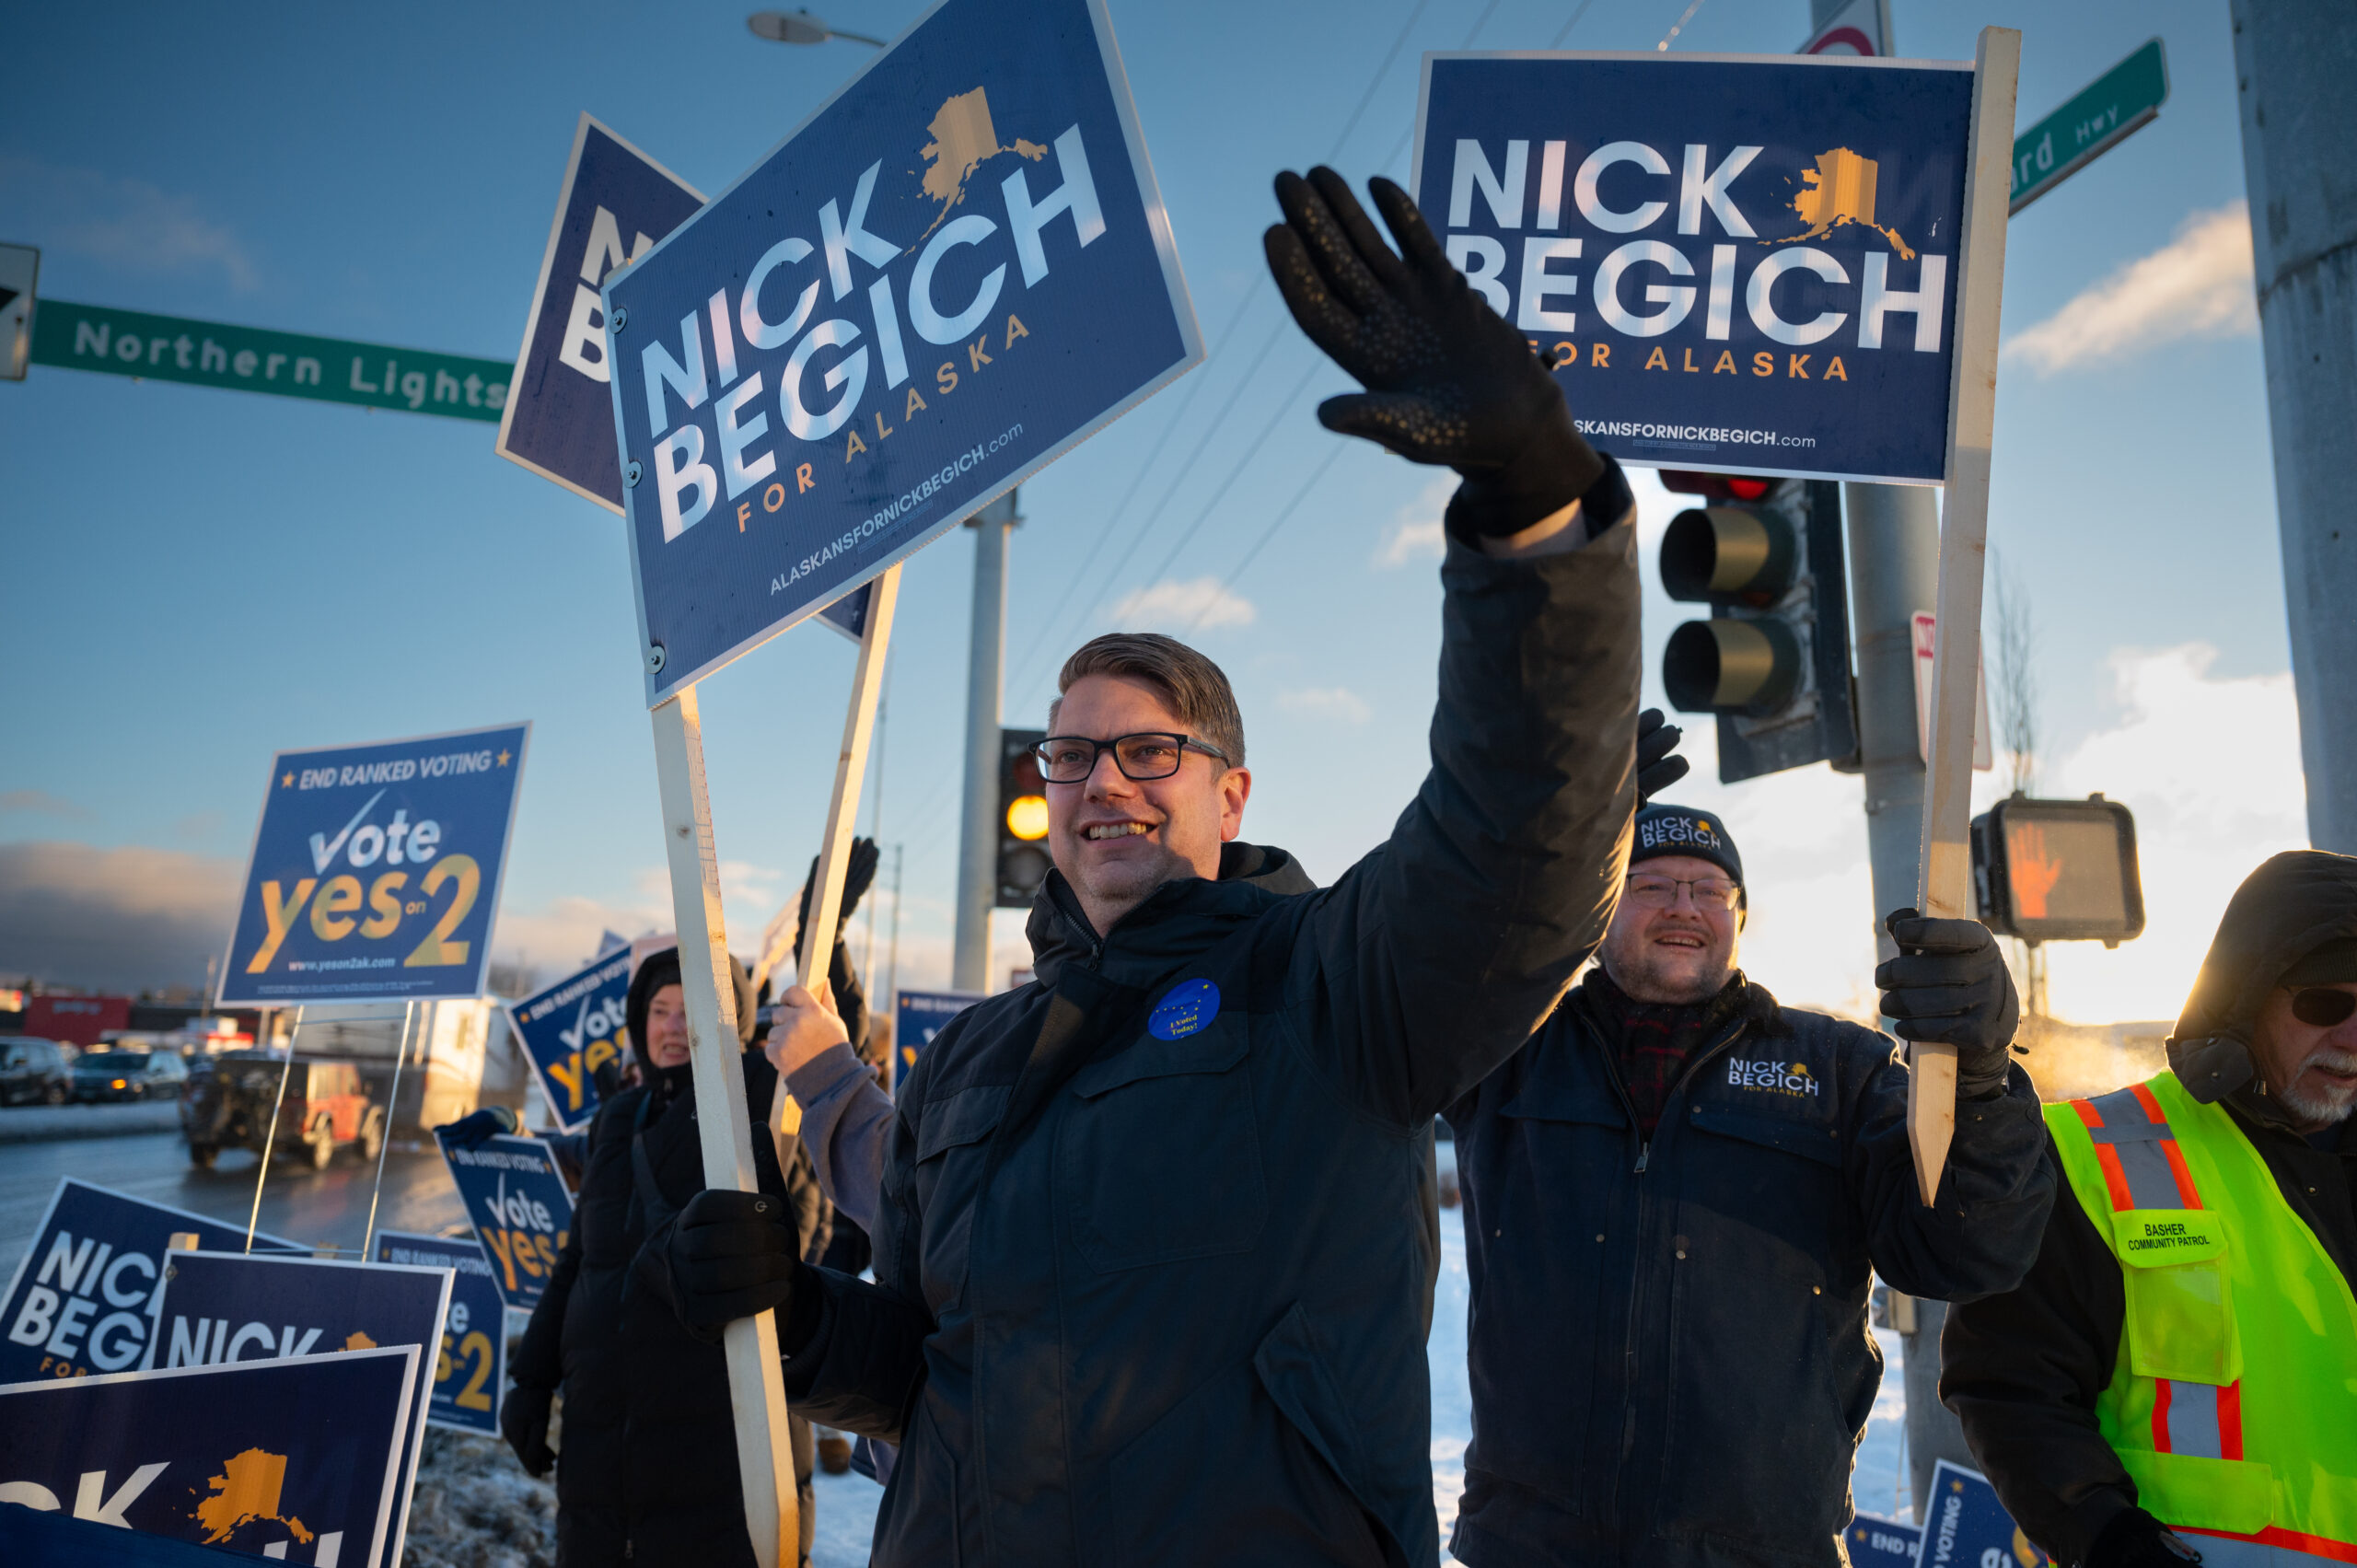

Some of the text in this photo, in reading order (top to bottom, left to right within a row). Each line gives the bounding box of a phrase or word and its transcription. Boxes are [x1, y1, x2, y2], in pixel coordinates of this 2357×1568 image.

[1447, 138, 1765, 238] NICK
[641, 157, 903, 439] NICK
[1446, 234, 1947, 353] BEGICH
[654, 122, 1107, 544] BEGICH
[74, 319, 509, 409] Northern Lights
[1644, 346, 1848, 381] ALASKA
[737, 462, 817, 533] FOR
[844, 314, 1029, 463] ALASKA
[1573, 420, 1816, 448] SKANSFORNICKBEGICH.com
[771, 423, 1024, 596] ALASKANSFORNICKBEGICH.com
[299, 749, 493, 790] END RANKED VOTING
[1641, 817, 1693, 835] NICK
[1643, 828, 1721, 850] BEGICH
[246, 854, 481, 974] yes on 2
[1176, 1014, 1198, 1026] Voted
[1728, 1071, 1818, 1097] BEGICH
[1730, 1057, 1786, 1074] NICK
[1766, 1087, 1805, 1098] ALASKA
[2129, 1236, 2210, 1250] COMMUNITY PATROL
[2144, 1224, 2187, 1237] BASHER
[36, 1230, 166, 1318] NIC
[8, 1285, 155, 1372] BEG
[168, 1316, 323, 1369] NICK
[455, 1330, 493, 1412] 2
[1871, 1532, 1905, 1555] END
[1934, 1495, 1962, 1562] VOTING
